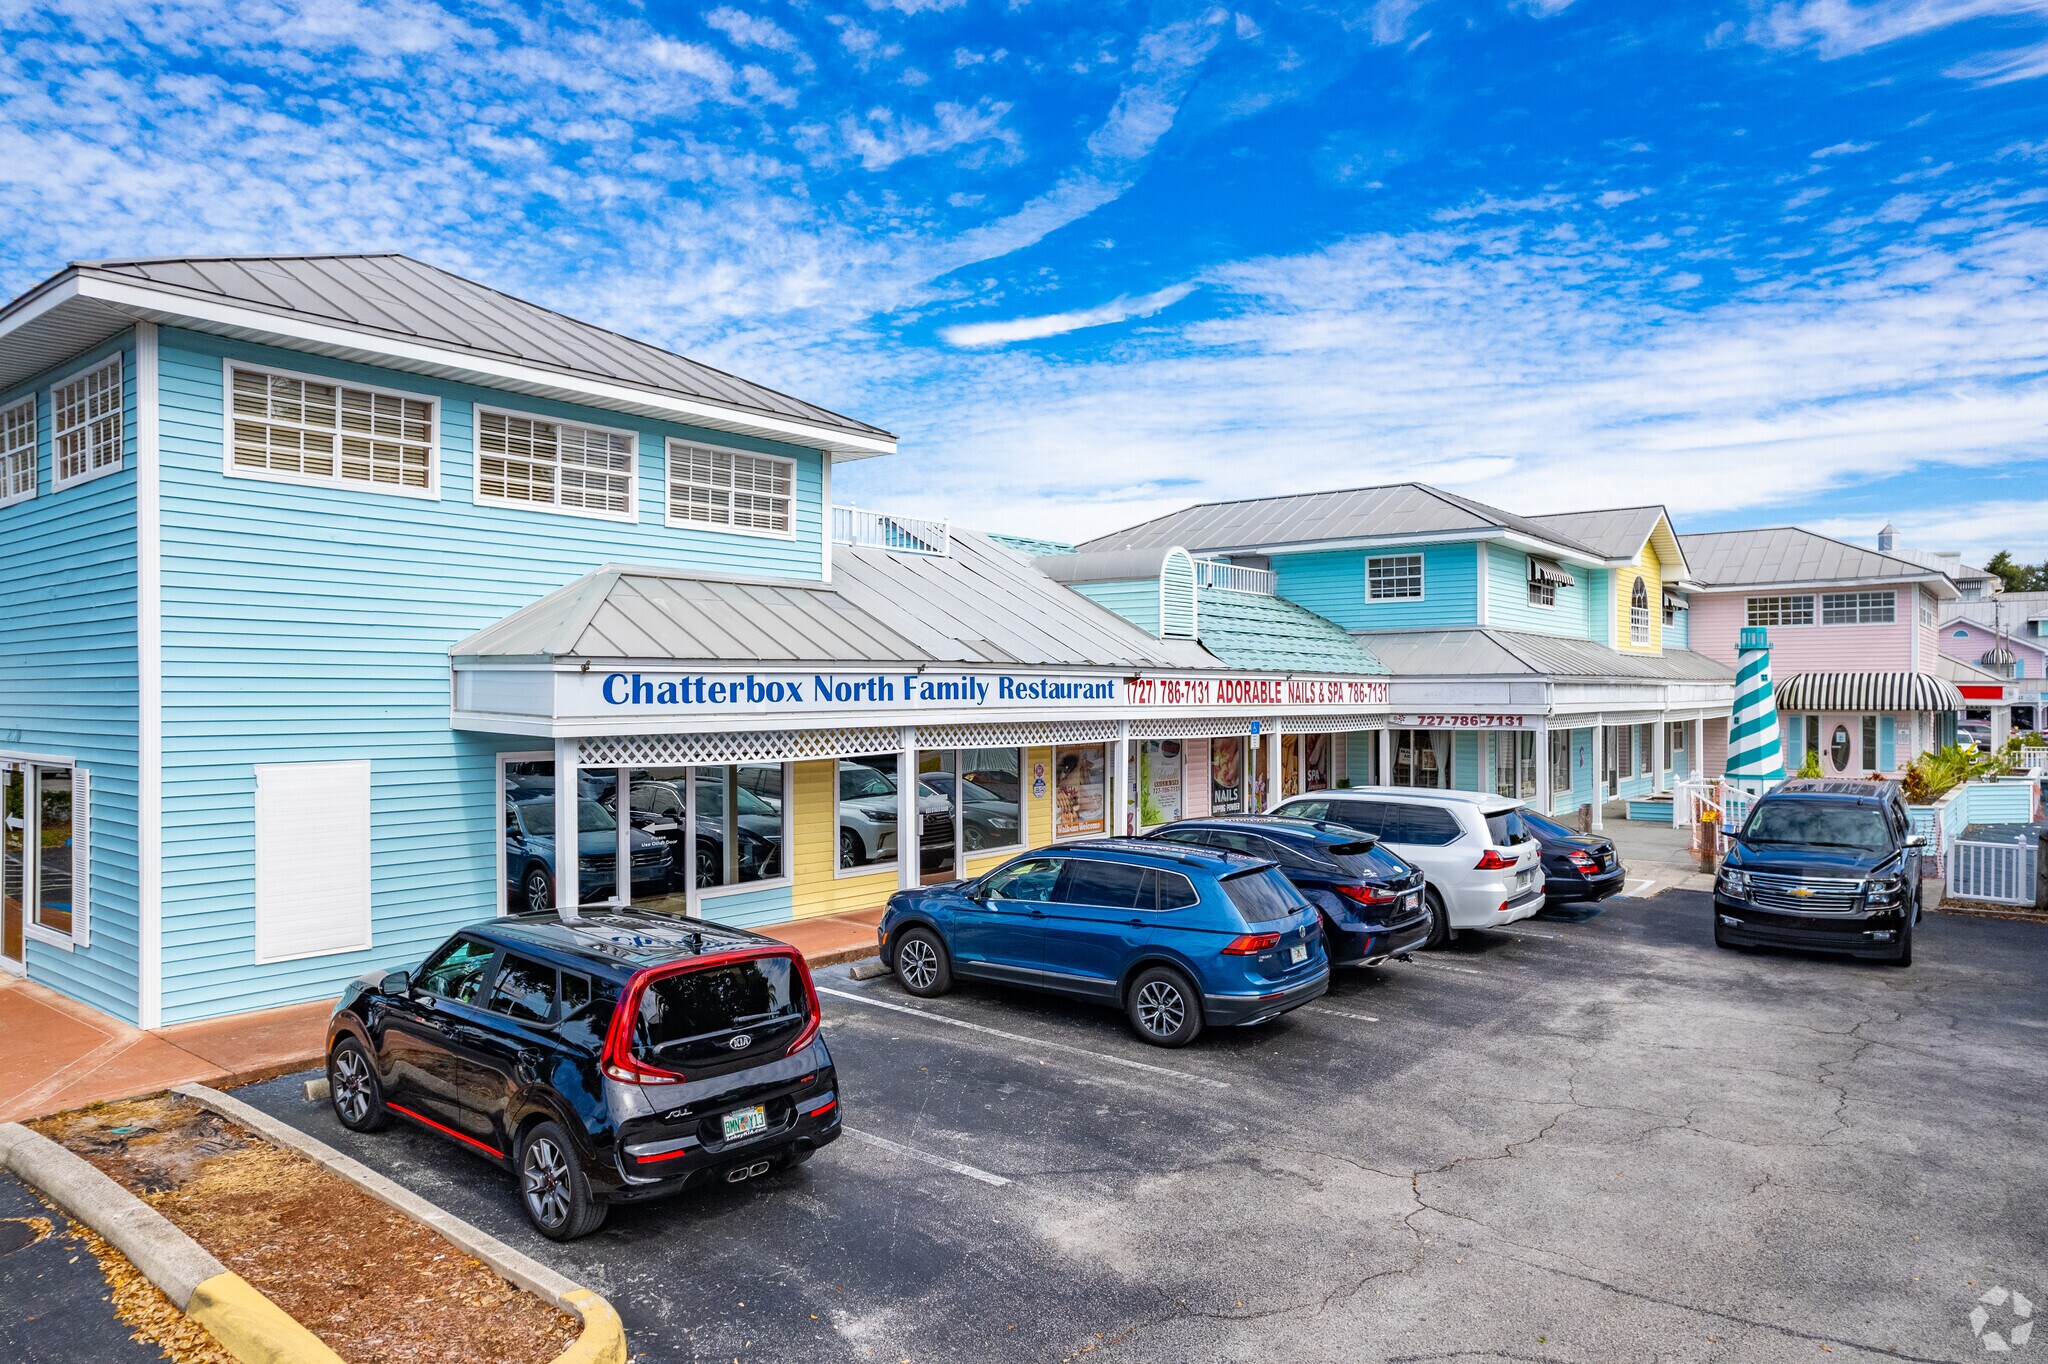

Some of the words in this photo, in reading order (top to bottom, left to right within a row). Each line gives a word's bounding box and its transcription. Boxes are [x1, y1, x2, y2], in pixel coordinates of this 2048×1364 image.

[602, 673, 804, 705] Chatterbox
[814, 675, 894, 702] North
[903, 675, 989, 705] Family
[999, 676, 1115, 700] Restaurant
[1127, 679, 1156, 705] (727)
[1160, 680, 1210, 704] 786-7131
[1216, 680, 1282, 704] ADORABLE
[1288, 682, 1315, 704] NAILS
[1318, 682, 1325, 703] &
[1327, 682, 1344, 703] SPA
[1347, 683, 1388, 703] 786-7131
[1417, 715, 1523, 727] 727-786-7131
[1307, 769, 1320, 781] SPA
[1214, 788, 1238, 803] NAILS
[1226, 802, 1240, 812] POWDER
[1079, 822, 1101, 831] Welcome
[733, 1037, 750, 1048] KIA
[725, 1118, 740, 1134] BMN
[749, 1112, 764, 1127] Y13
